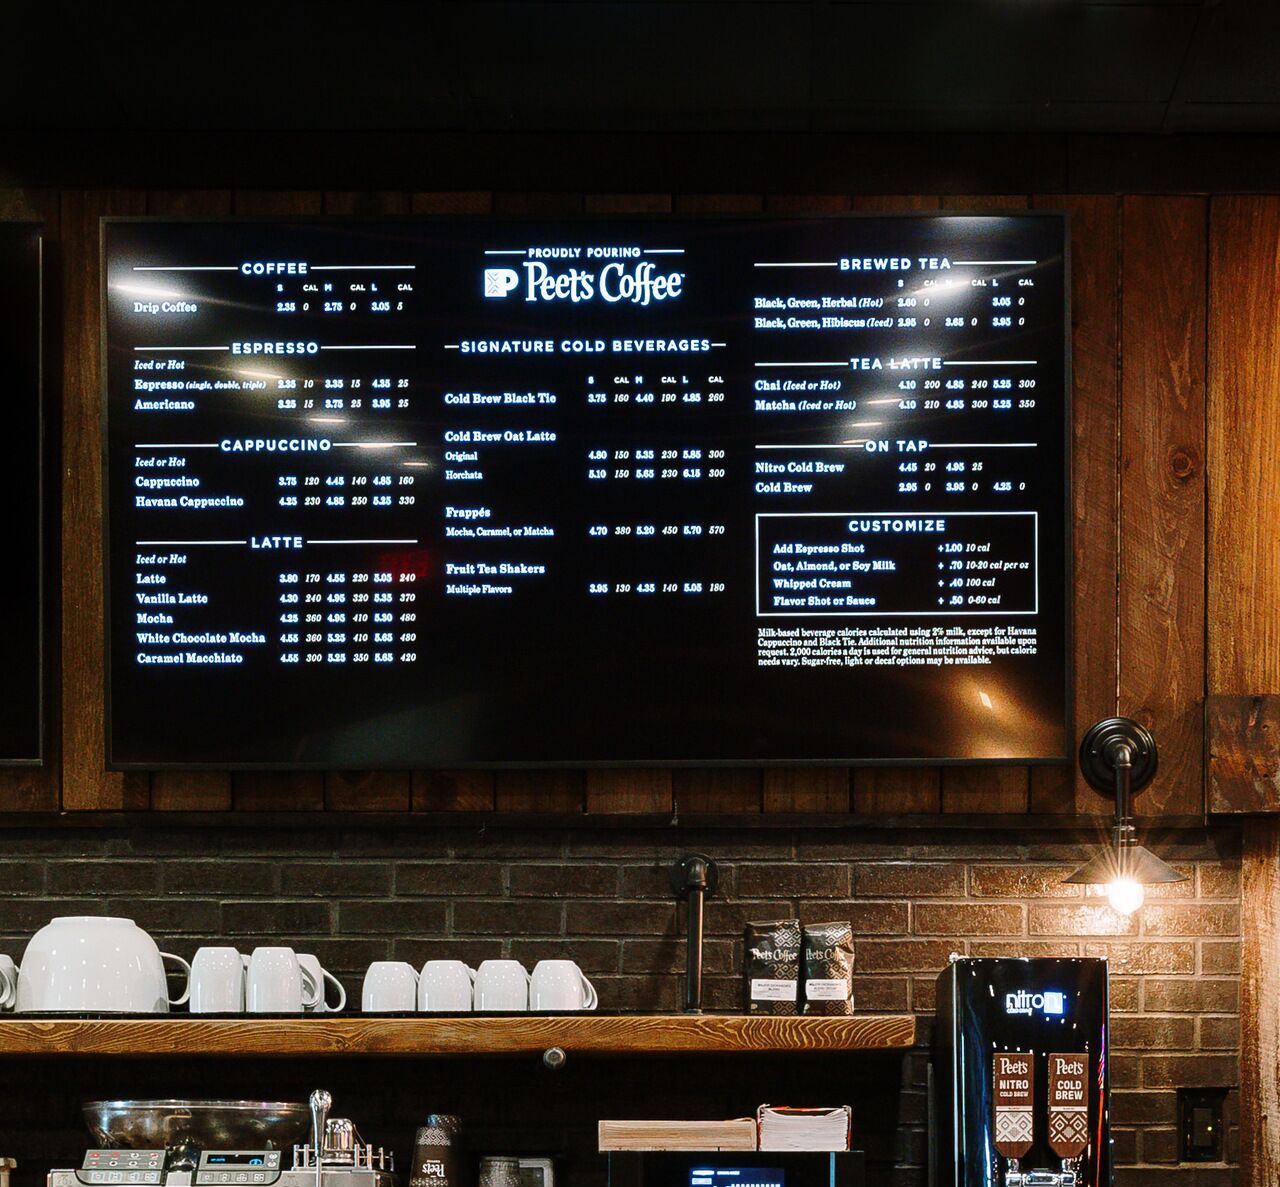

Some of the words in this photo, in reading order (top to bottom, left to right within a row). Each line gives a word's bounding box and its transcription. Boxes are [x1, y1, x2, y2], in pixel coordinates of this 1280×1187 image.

[528, 248, 581, 258] PROUDLY
[587, 247, 641, 258] POURING
[241, 262, 307, 275] COFFEE
[840, 258, 911, 270] BREWED
[918, 258, 951, 270] TEA
[522, 261, 594, 303] Peet's
[599, 261, 685, 306] Coffee
[134, 302, 160, 314] Drip
[162, 302, 197, 312] Coffee
[754, 297, 786, 310] Black,
[787, 297, 821, 309] Green,
[821, 297, 857, 308] Herbal
[858, 297, 884, 308] (Hot)
[754, 317, 787, 329] Black,
[787, 317, 821, 329] Green,
[822, 317, 865, 328] Hibiscus
[866, 317, 893, 328] (Iced)
[232, 342, 318, 354] ESPRESSO
[461, 340, 554, 352] SIGNATURE
[561, 340, 605, 352] COLD
[612, 339, 710, 352] BEVERAGES
[134, 360, 154, 370] Iced
[167, 359, 185, 370] Hot
[850, 358, 882, 370] TEA
[890, 358, 942, 370] LATTE
[134, 379, 184, 392] Espresso
[185, 380, 212, 391] (single,
[214, 380, 241, 391] double,
[242, 380, 266, 391] triple)
[754, 380, 781, 391] Chai
[782, 380, 806, 391] (Iced
[819, 380, 841, 390] Hot)
[444, 393, 470, 404] Cold
[472, 393, 502, 404] Brew
[503, 392, 536, 403] Black
[537, 392, 556, 403] Tie
[134, 399, 195, 410] Americano
[444, 431, 471, 442] Cold
[472, 431, 502, 442] Brew
[503, 430, 524, 442] Oat
[526, 430, 556, 441] Latte
[221, 439, 331, 451] CAPPUCCINO
[865, 441, 889, 452] ON
[896, 440, 928, 452] TAP
[445, 451, 478, 462] Original
[755, 462, 786, 473] Nitro
[787, 462, 813, 473] Cold
[815, 461, 845, 472] Brew
[898, 462, 918, 472] 4.45
[924, 462, 936, 472] 20
[945, 462, 965, 472] 4.95
[971, 462, 983, 471] 25
[445, 470, 483, 480] Horchata
[135, 476, 200, 489] Cappuccino
[278, 476, 297, 486] 3.75
[304, 476, 320, 485] 120
[325, 476, 344, 486] 4.45
[352, 476, 367, 485] 140
[372, 476, 392, 486] 4.85
[398, 476, 414, 485] 160
[755, 482, 781, 493] Cold
[783, 482, 813, 492] Brew
[135, 496, 178, 507] Havana
[179, 495, 244, 508] Cappuccino
[445, 506, 491, 520] Frappés
[446, 527, 476, 537] Mocha,
[476, 526, 512, 537] Caramel,
[523, 526, 554, 536] Matcha
[848, 520, 945, 532] CUSTOMIZE
[251, 536, 302, 548] LATTE
[773, 543, 793, 554] Add
[794, 543, 840, 555] Espresso
[841, 543, 865, 553] Shot
[446, 563, 476, 574] Fruit
[476, 563, 498, 574] Tea
[499, 563, 545, 574] Shakers
[773, 561, 794, 572] Oat,
[796, 560, 838, 572] Almond,
[852, 560, 871, 572] Soy
[872, 560, 896, 570] Milk
[136, 573, 166, 584] Latte
[773, 578, 817, 590] Whipped
[818, 578, 852, 588] Cream
[446, 584, 481, 596] Multiple
[482, 584, 512, 594] Flavors
[136, 593, 176, 604] Vanilla
[178, 593, 208, 604] Latte
[136, 613, 174, 624] Mocha
[136, 633, 170, 643] White
[172, 632, 227, 643] Chocolate
[229, 632, 266, 643] Mocha
[137, 652, 184, 664] Caramel
[185, 652, 243, 663] Macchiato
[1000, 1080, 1028, 1089] NITRO
[1057, 1080, 1082, 1090] COLD
[1056, 1090, 1083, 1100] BREW
